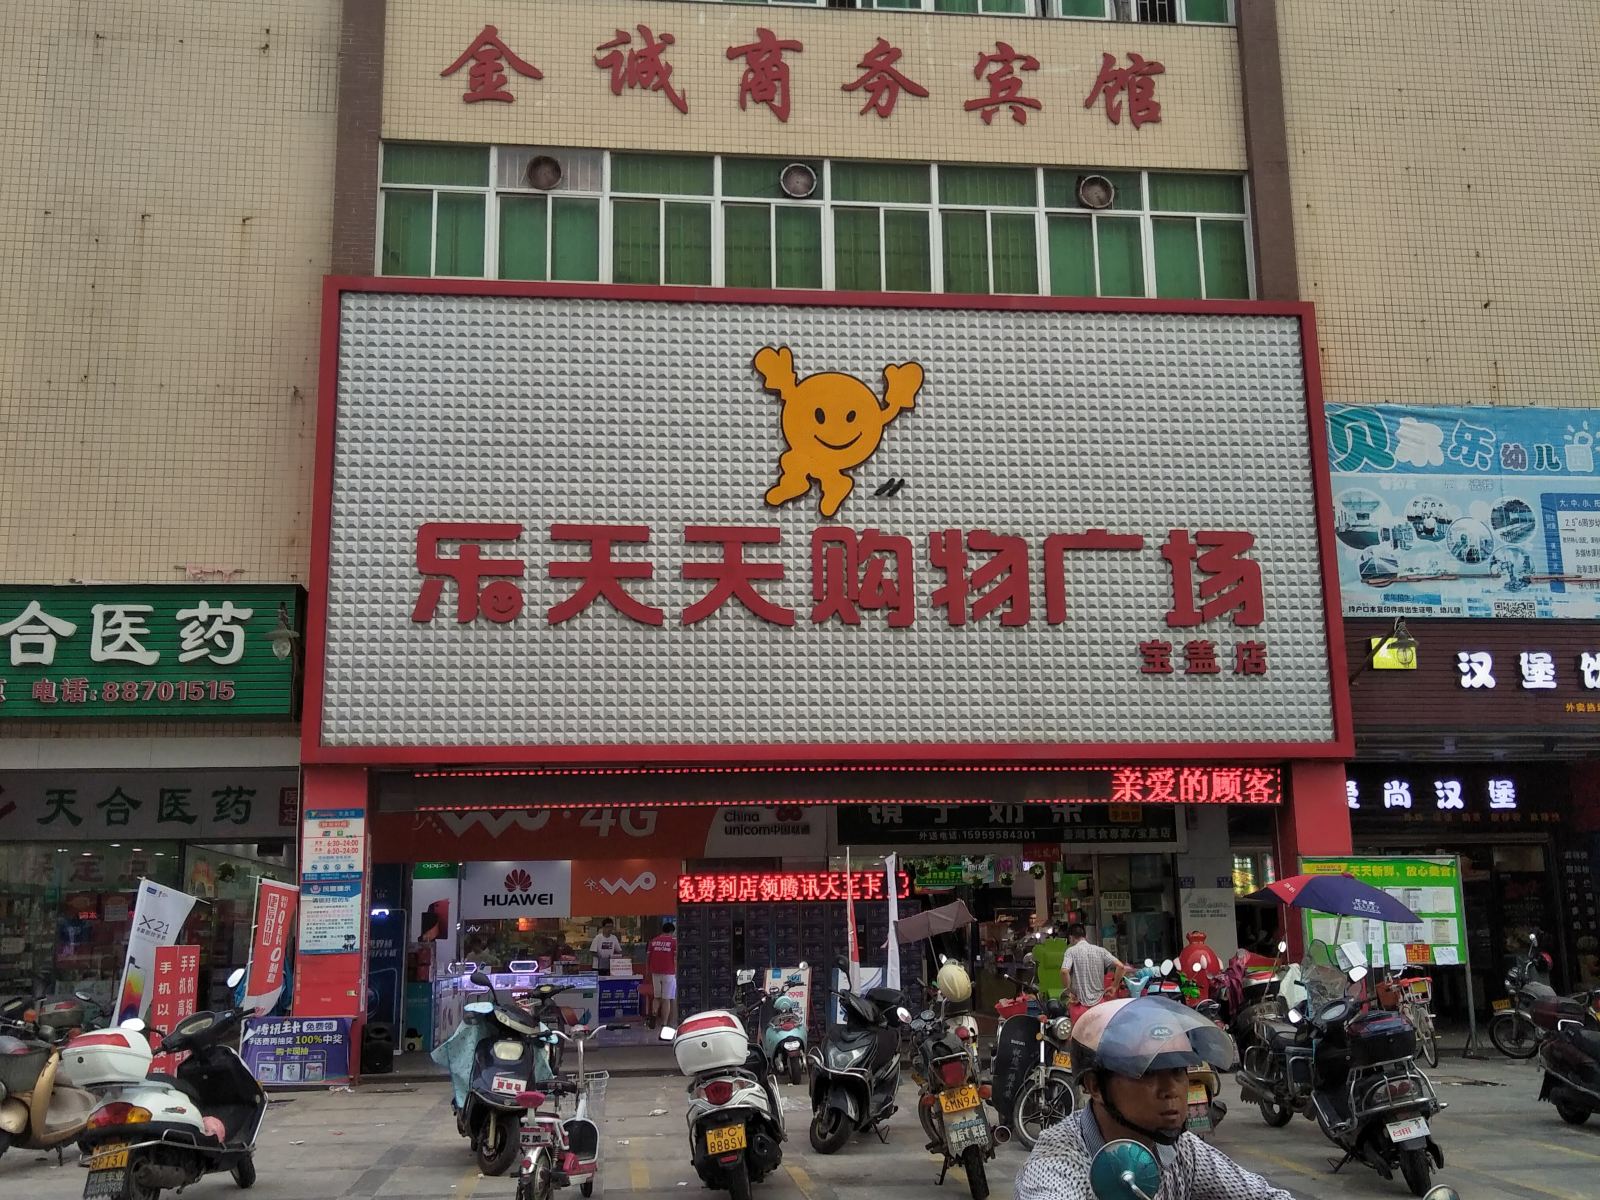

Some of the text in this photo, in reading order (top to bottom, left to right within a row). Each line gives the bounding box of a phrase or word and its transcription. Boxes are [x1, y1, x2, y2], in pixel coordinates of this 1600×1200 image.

[441, 25, 1165, 129] 金诚商务宾馆
[412, 522, 1265, 628] 乐天天购物广场
[0, 600, 253, 666] 合医药
[1140, 640, 1267, 675] 宝盖店
[1111, 768, 1274, 802] 亲爱的顾客
[37, 785, 257, 827] 天合医药
[724, 811, 759, 822] China
[483, 893, 554, 907] HUAWEI
[139, 915, 170, 935] X21
[710, 1136, 743, 1153] 888SV
